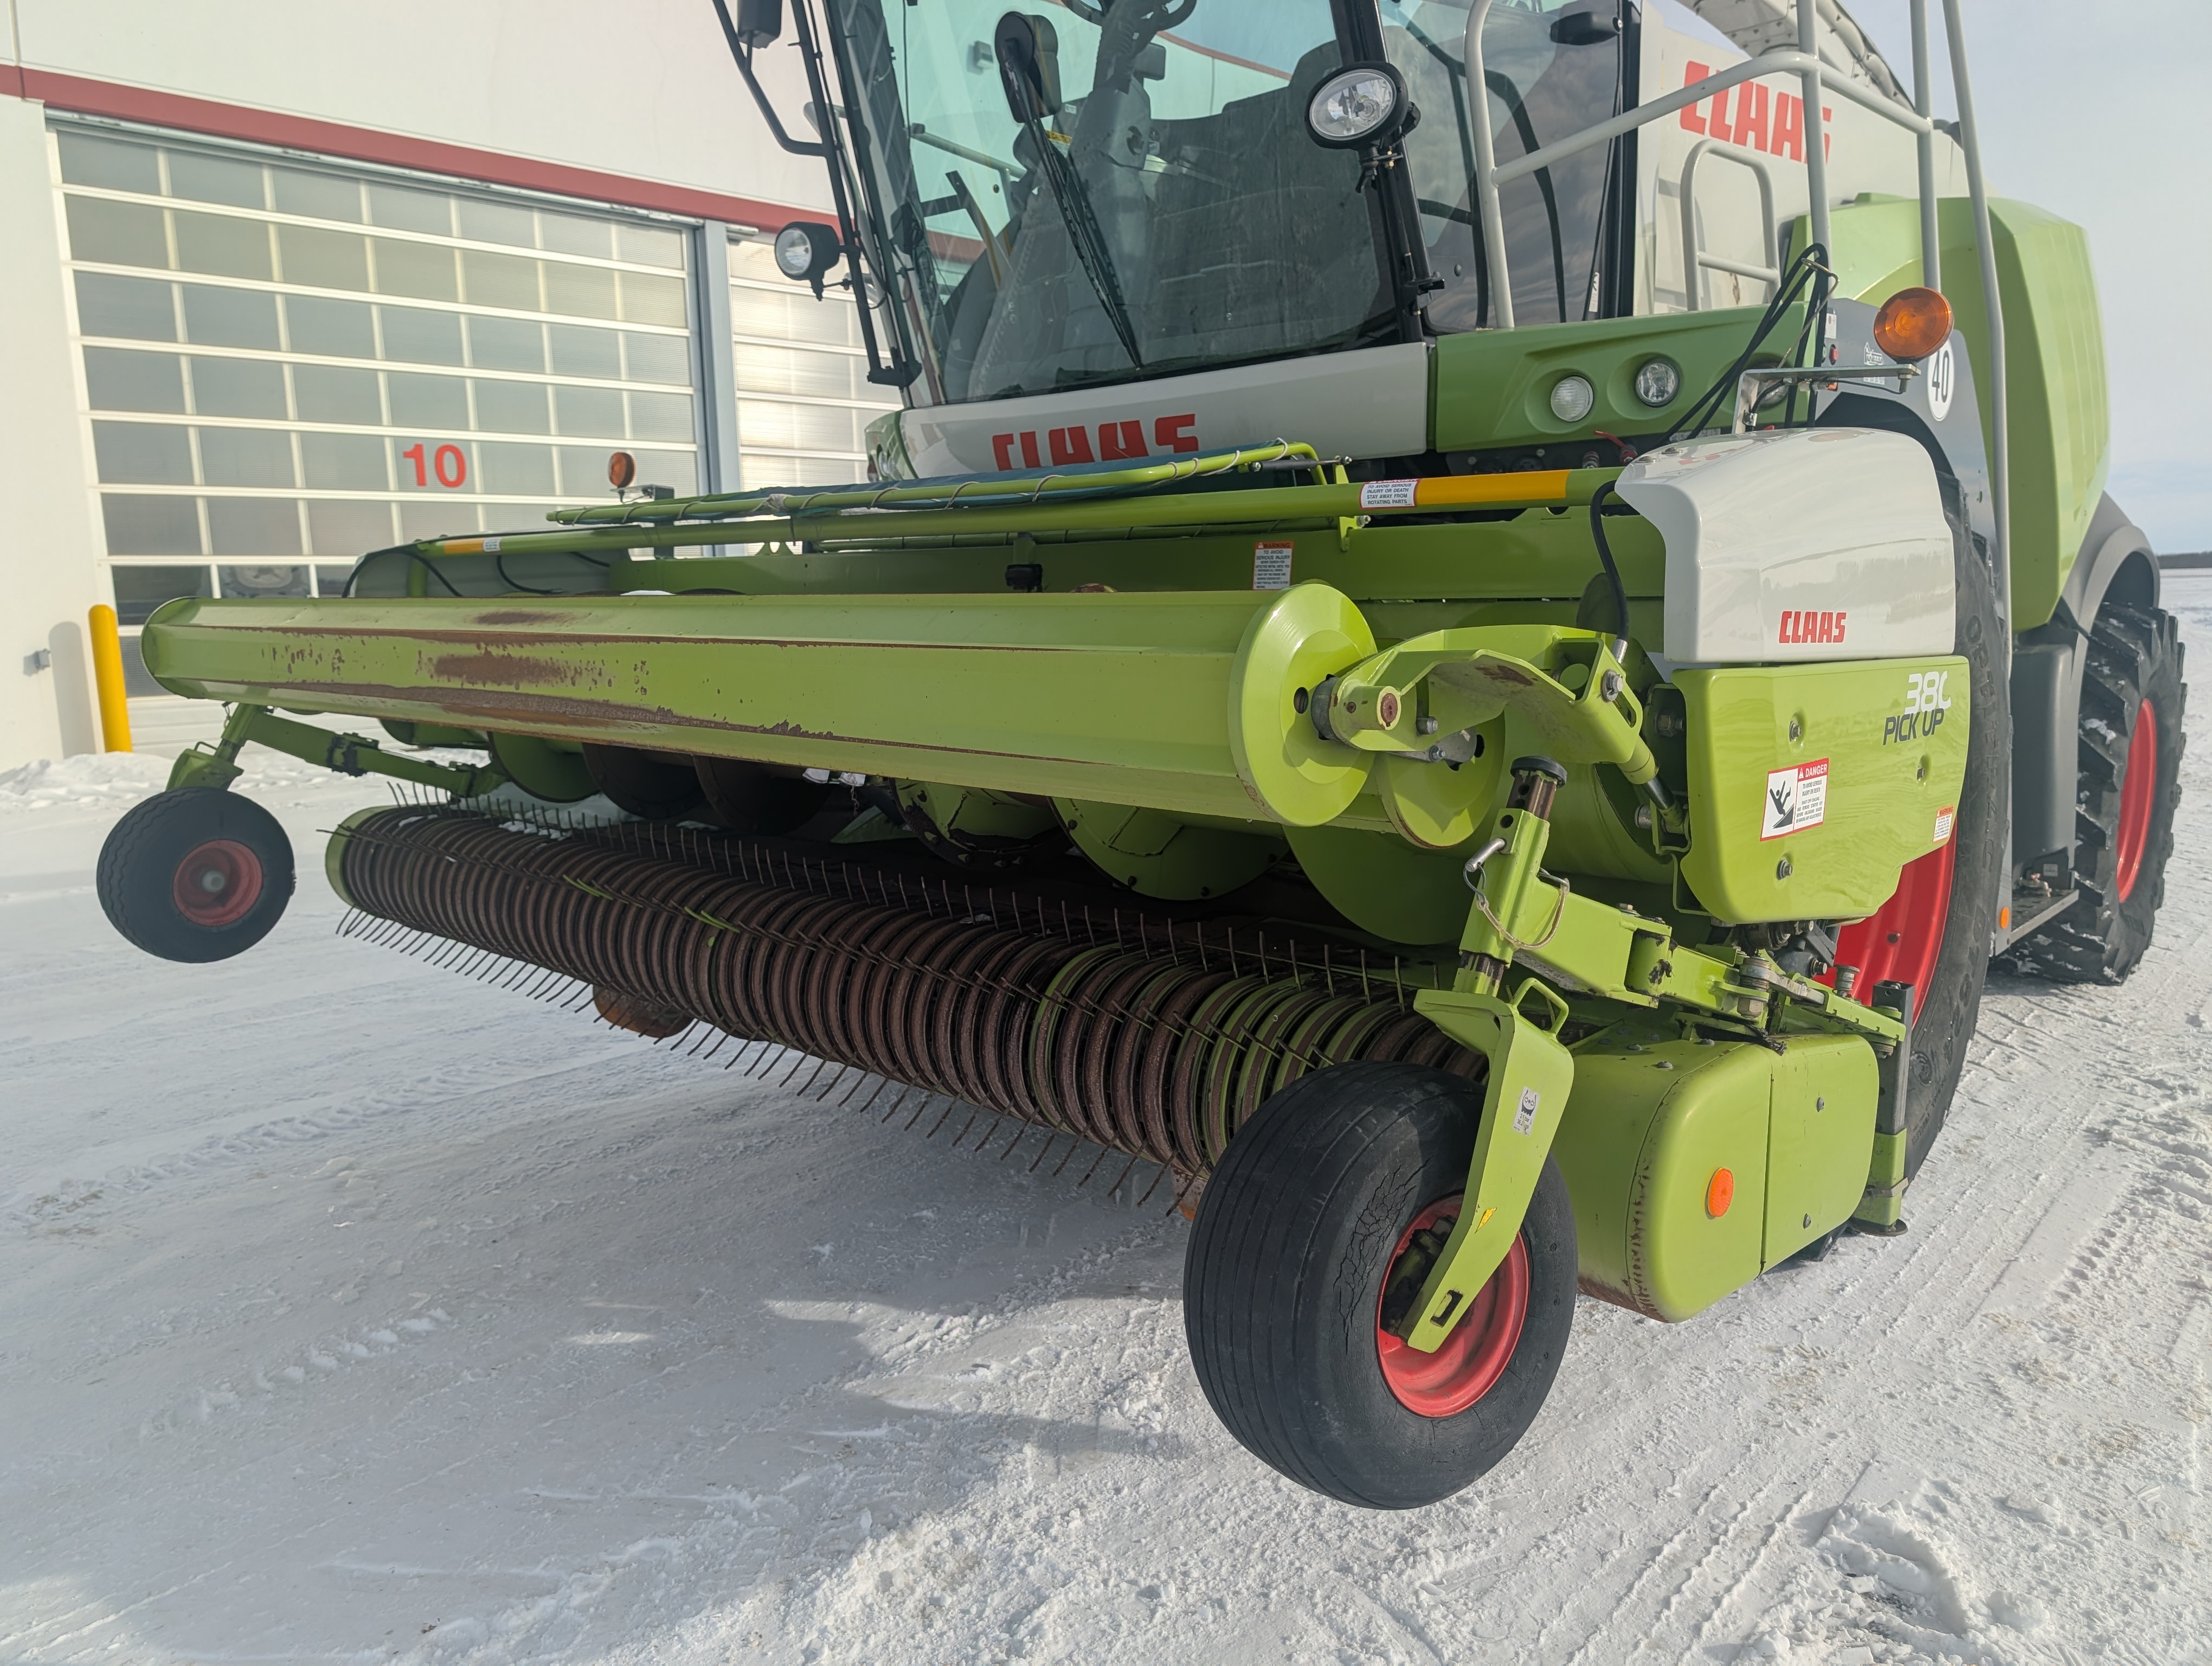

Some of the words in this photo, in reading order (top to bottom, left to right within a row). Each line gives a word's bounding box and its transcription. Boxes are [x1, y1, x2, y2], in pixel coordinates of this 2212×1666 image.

[1932, 350, 1949, 402] 40
[403, 443, 466, 488] 10
[1779, 611, 1847, 644] CLAAS
[1883, 713, 1920, 746] PICK
[1922, 708, 1945, 737] UP
[1805, 764, 1828, 778] DANGER
